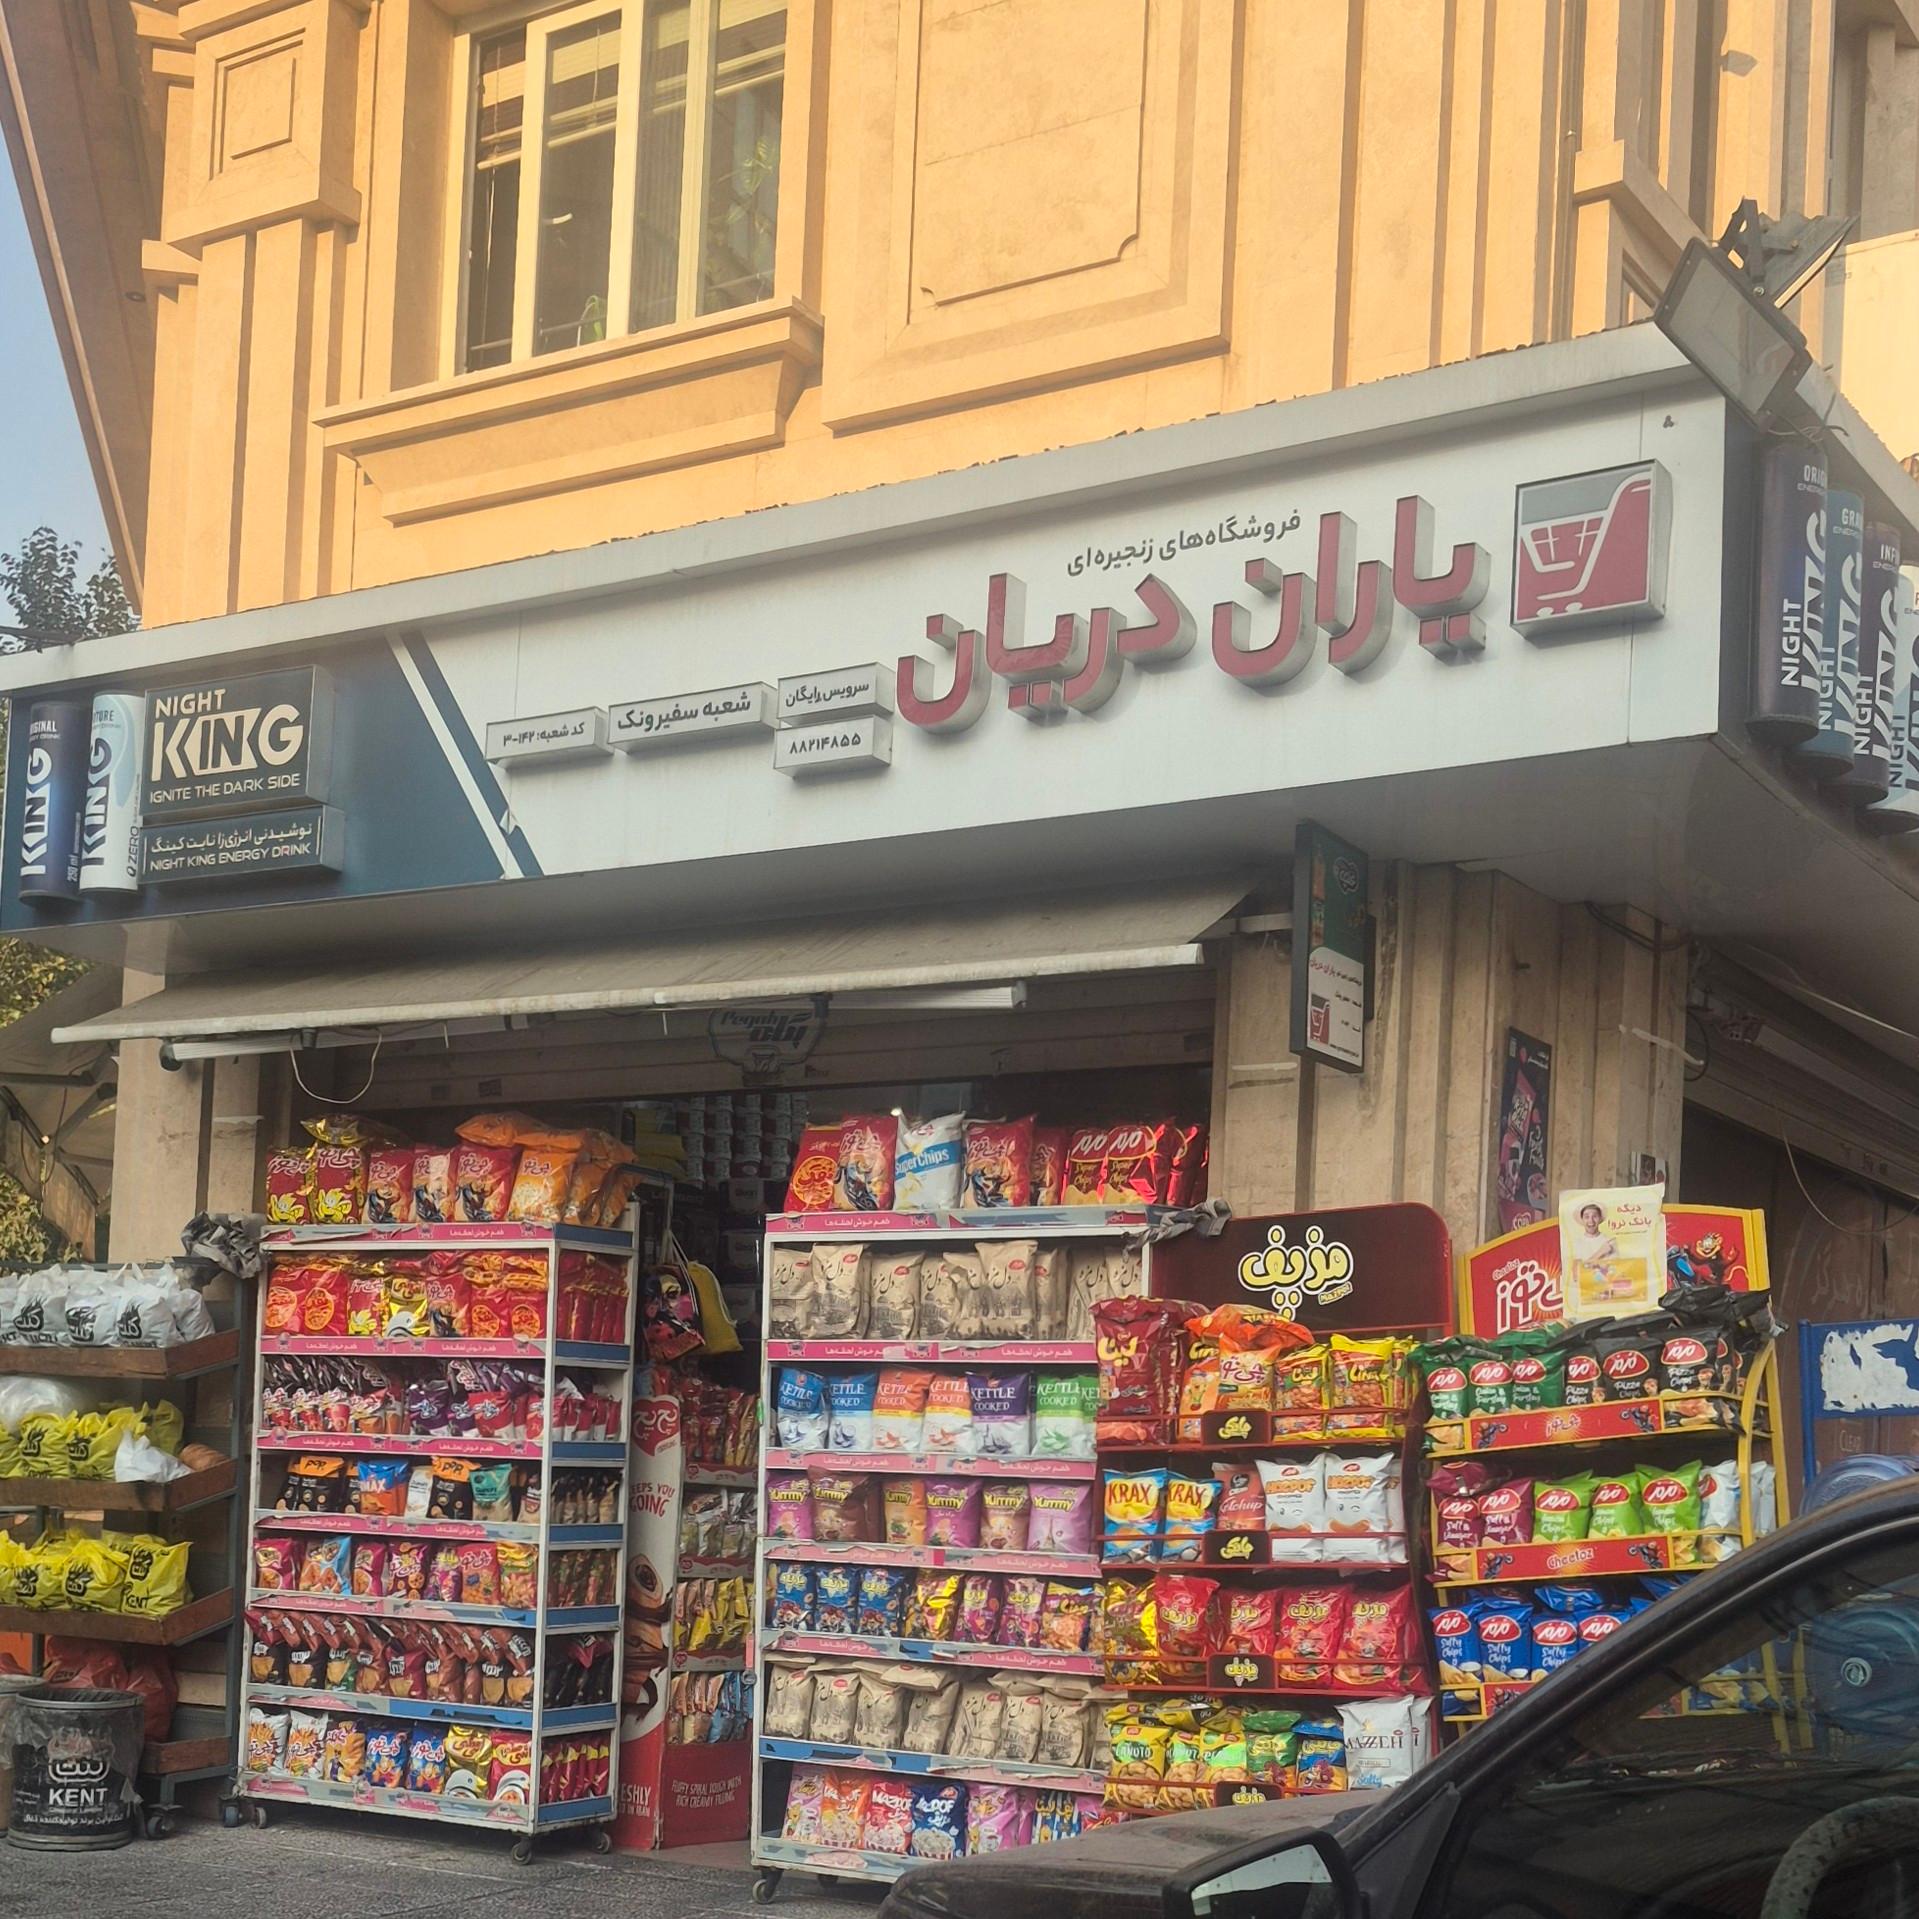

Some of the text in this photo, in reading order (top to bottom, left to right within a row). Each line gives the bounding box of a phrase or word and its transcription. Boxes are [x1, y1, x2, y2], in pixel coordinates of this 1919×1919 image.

[1159, 509, 1301, 561] فروشگاه‌های
[897, 495, 1486, 728] یاران دریان
[1781, 598, 1801, 686] NIGHT
[785, 682, 870, 708] سرویس رایگان
[1818, 647, 1835, 730] NIGHT
[155, 688, 226, 718] NIGHT
[703, 690, 751, 722] شعبه
[1853, 672, 1874, 755] NIGHT
[571, 722, 585, 737] کد
[151, 704, 304, 782] KING
[789, 732, 862, 755] ۸۸۲۱۴۸۵۵
[1889, 715, 1906, 788] NIGHT
[150, 773, 301, 804] IGNITE THE DARK SIDE
[20, 747, 52, 876] KING
[80, 737, 112, 866] KING
[152, 836, 185, 855] کینگ
[186, 834, 216, 851] نایت
[254, 823, 313, 845] نوشیدنی
[150, 842, 311, 872] NIGHT KING ENERGY DRINK
[1666, 1341, 1695, 1361] مزمز
[1609, 1354, 1637, 1375] مزمز
[971, 1387, 1016, 1399] KETTLE
[657, 1482, 675, 1498] YOU
[1107, 1482, 1152, 1506] KRAX
[1540, 1491, 1570, 1508] مزمز
[1648, 1481, 1679, 1500] مزمز
[1547, 1547, 1595, 1570] Cheetoz
[1437, 1613, 1461, 1633] مزمز
[1482, 1618, 1510, 1638] مزمز
[1537, 1622, 1568, 1640] مزمز
[48, 1787, 109, 1808] KENT
